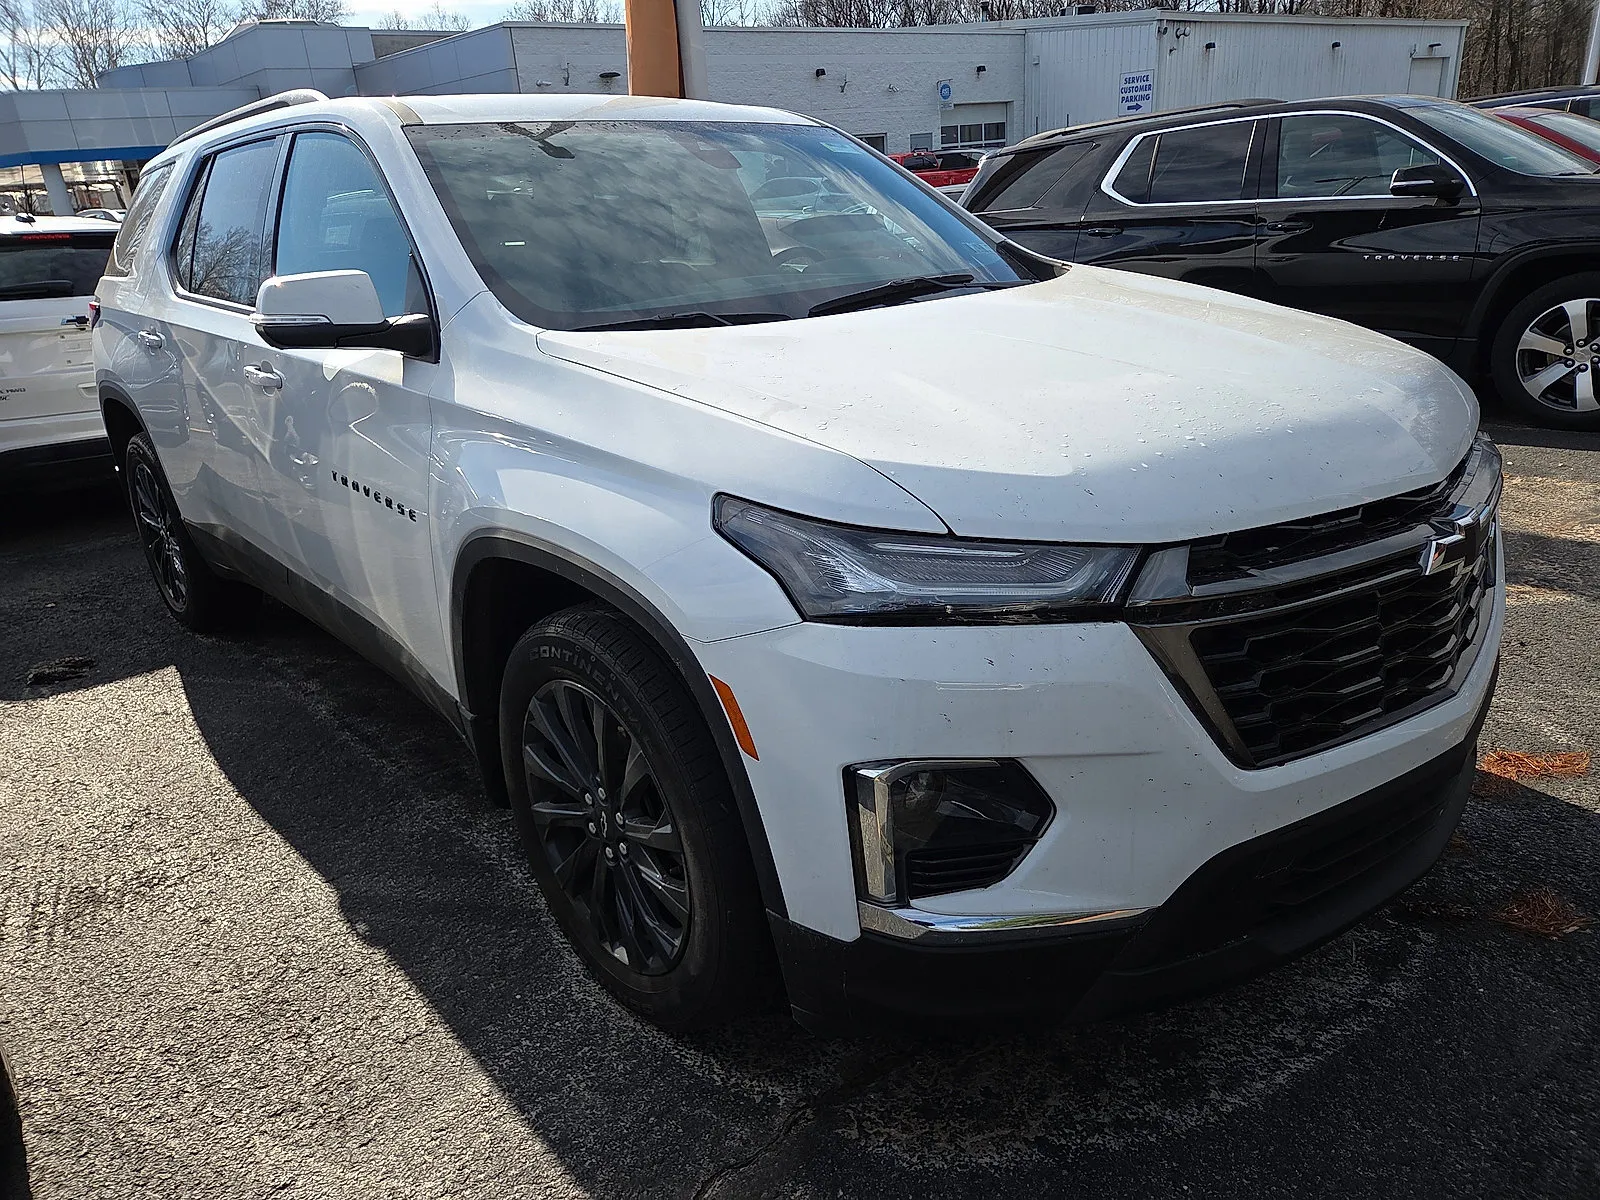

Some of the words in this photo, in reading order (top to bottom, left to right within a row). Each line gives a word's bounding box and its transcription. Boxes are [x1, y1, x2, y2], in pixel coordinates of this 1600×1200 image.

[1124, 74, 1150, 84] SERVICE
[1120, 84, 1152, 94] CUSTOMER
[1121, 94, 1150, 103] PARKING
[331, 470, 417, 523] TRAVERSE
[529, 645, 652, 750] CONTINENT
